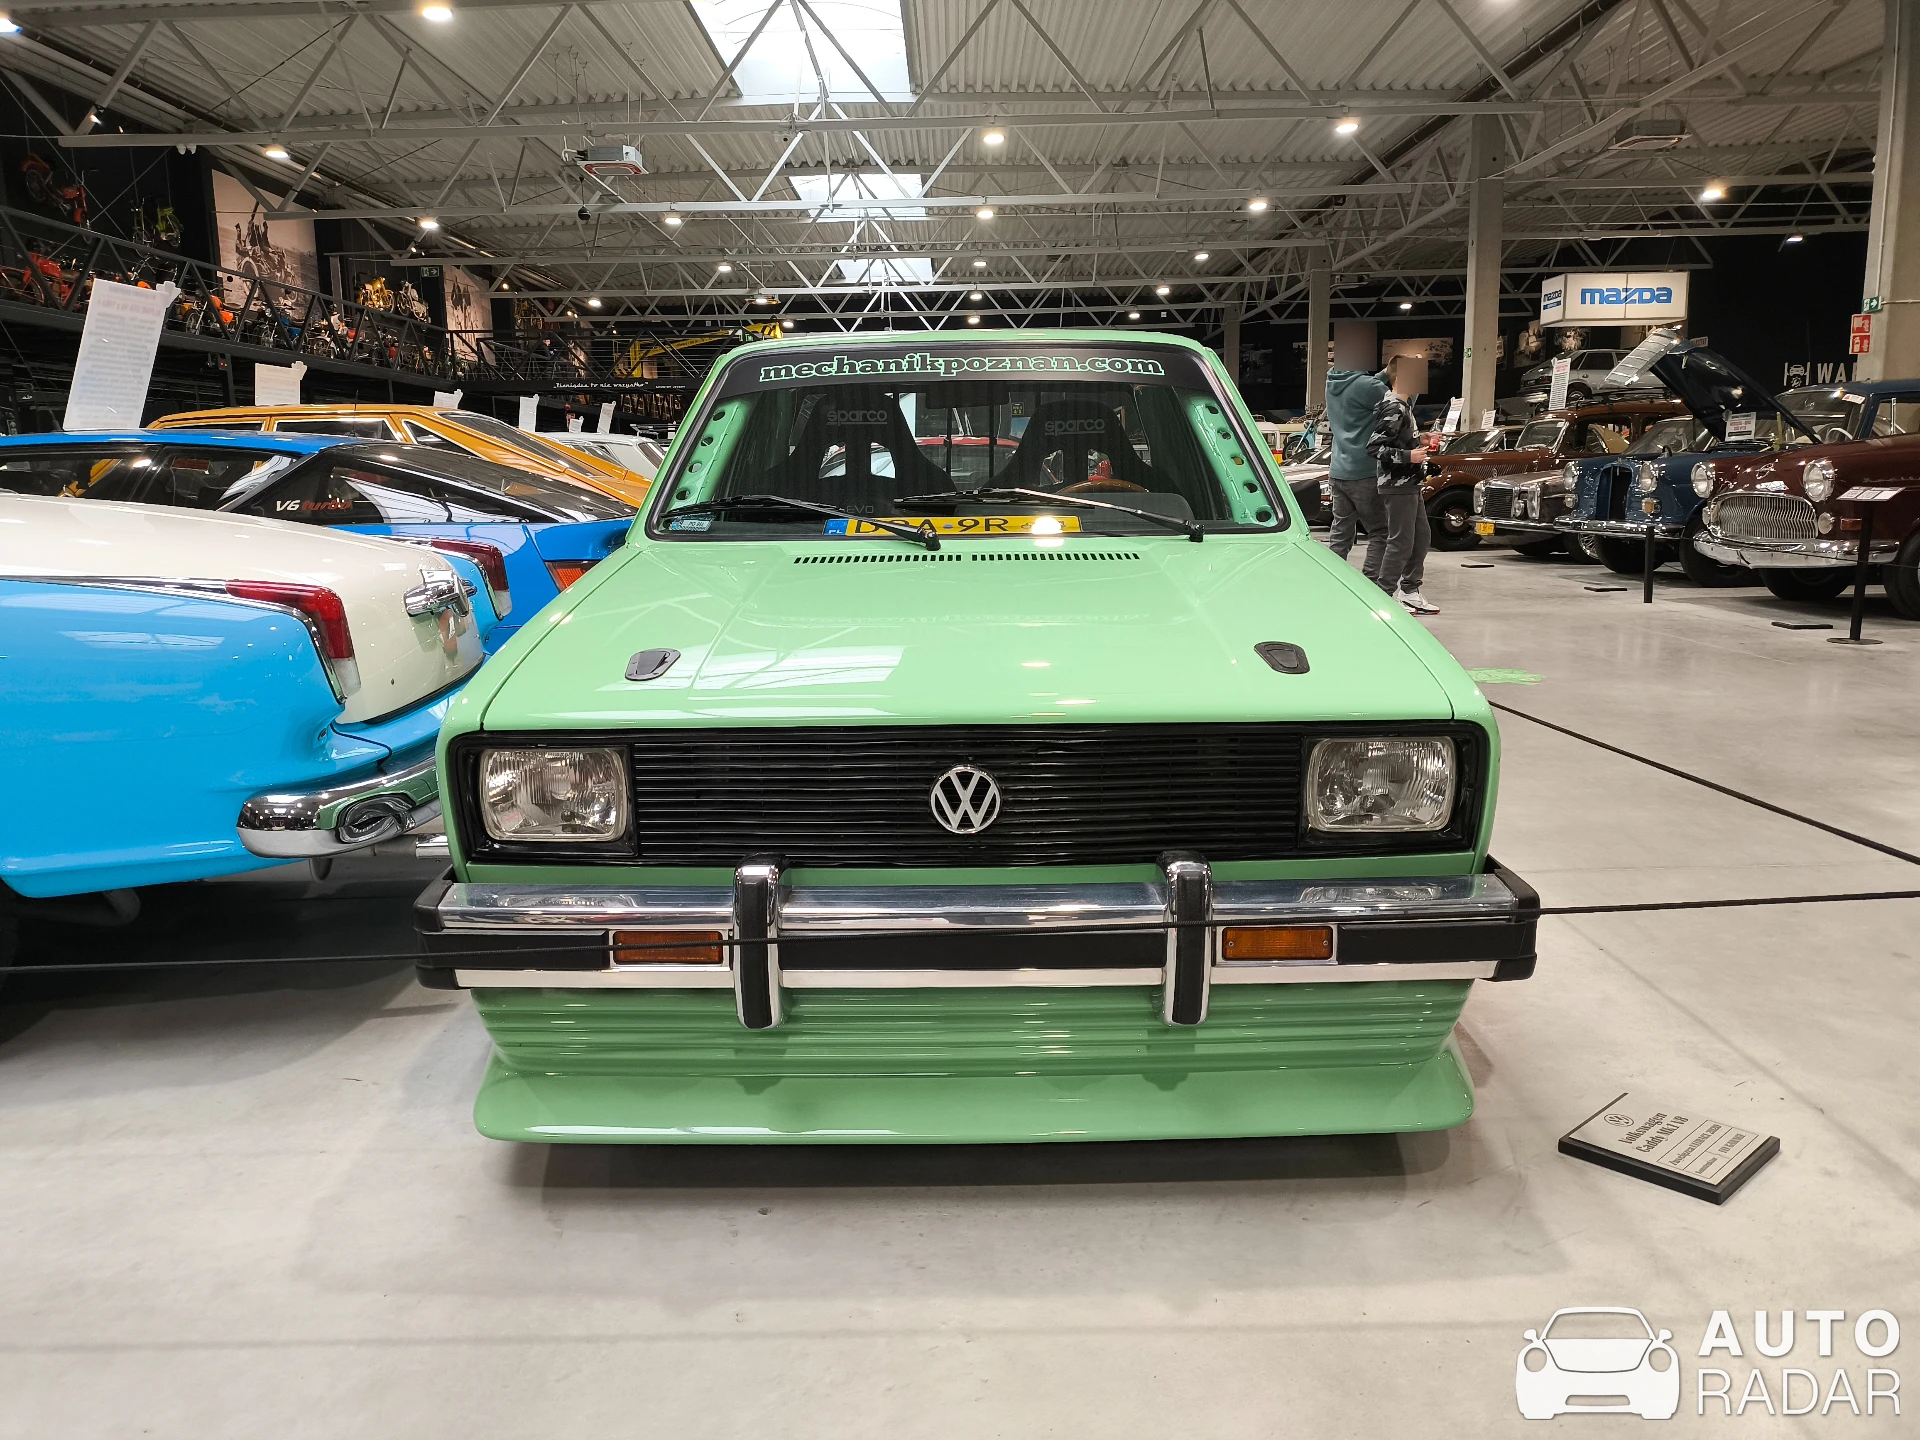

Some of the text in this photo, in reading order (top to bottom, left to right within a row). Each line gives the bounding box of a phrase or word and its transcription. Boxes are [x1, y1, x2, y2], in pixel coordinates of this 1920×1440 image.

[1581, 287, 1673, 305] mazda
[759, 353, 1165, 383] mechanikpoznan.com
[827, 410, 888, 426] sparco
[1045, 419, 1105, 436] sparco
[276, 499, 353, 512] V6 turbo
[847, 505, 874, 514] EVO
[958, 518, 1009, 533] 9R
[1618, 1113, 1667, 1144] Volkswagen
[1635, 1135, 1668, 1152] Caddy
[1670, 1115, 1689, 1125] V8
